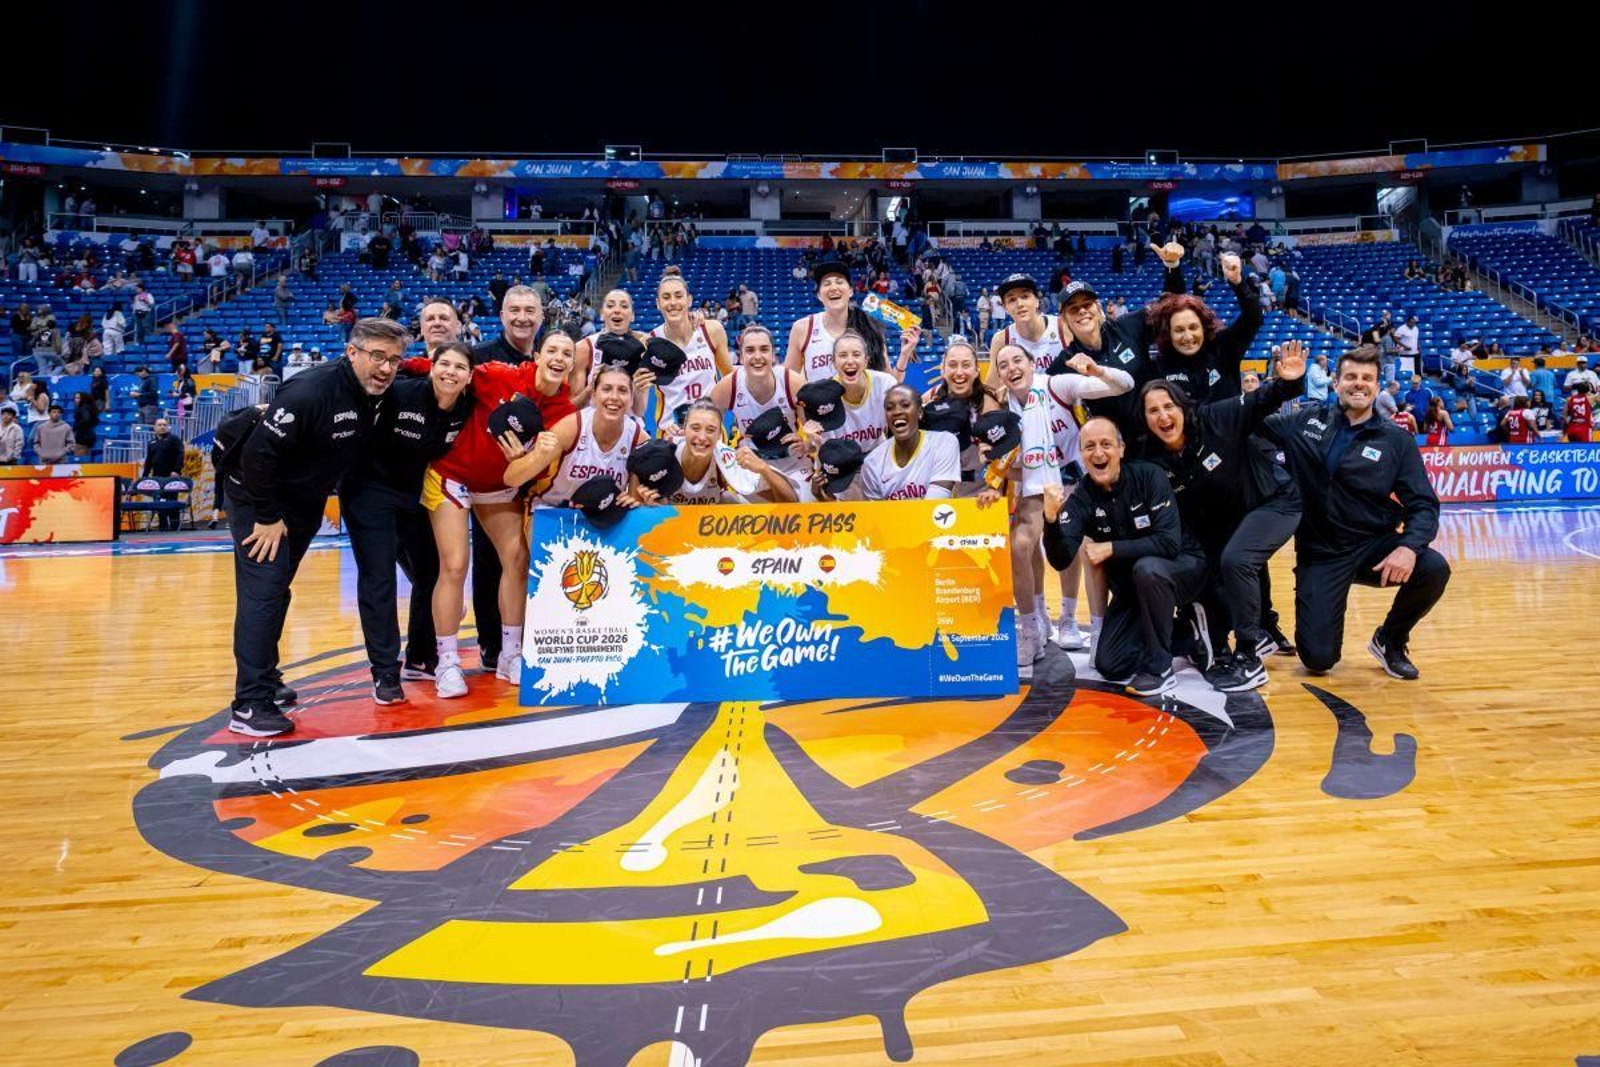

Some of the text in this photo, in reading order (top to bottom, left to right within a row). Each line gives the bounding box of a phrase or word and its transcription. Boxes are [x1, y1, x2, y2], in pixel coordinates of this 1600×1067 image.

[525, 164, 572, 174] SAN JUAN
[942, 167, 986, 176] SAN JUAN
[680, 355, 712, 375] PAÑA
[684, 383, 702, 400] 10
[398, 411, 425, 425] ESPAÑA
[1422, 452, 1454, 468] FIBA
[698, 511, 857, 537] BOARDING PASS
[751, 556, 803, 575] SPAIN
[575, 626, 629, 635] BASKETBALL
[533, 633, 629, 646] WORLD CUP 2026
[536, 644, 623, 655] QUALIFYING TOURNAMENTS
[537, 656, 552, 665] SAN
